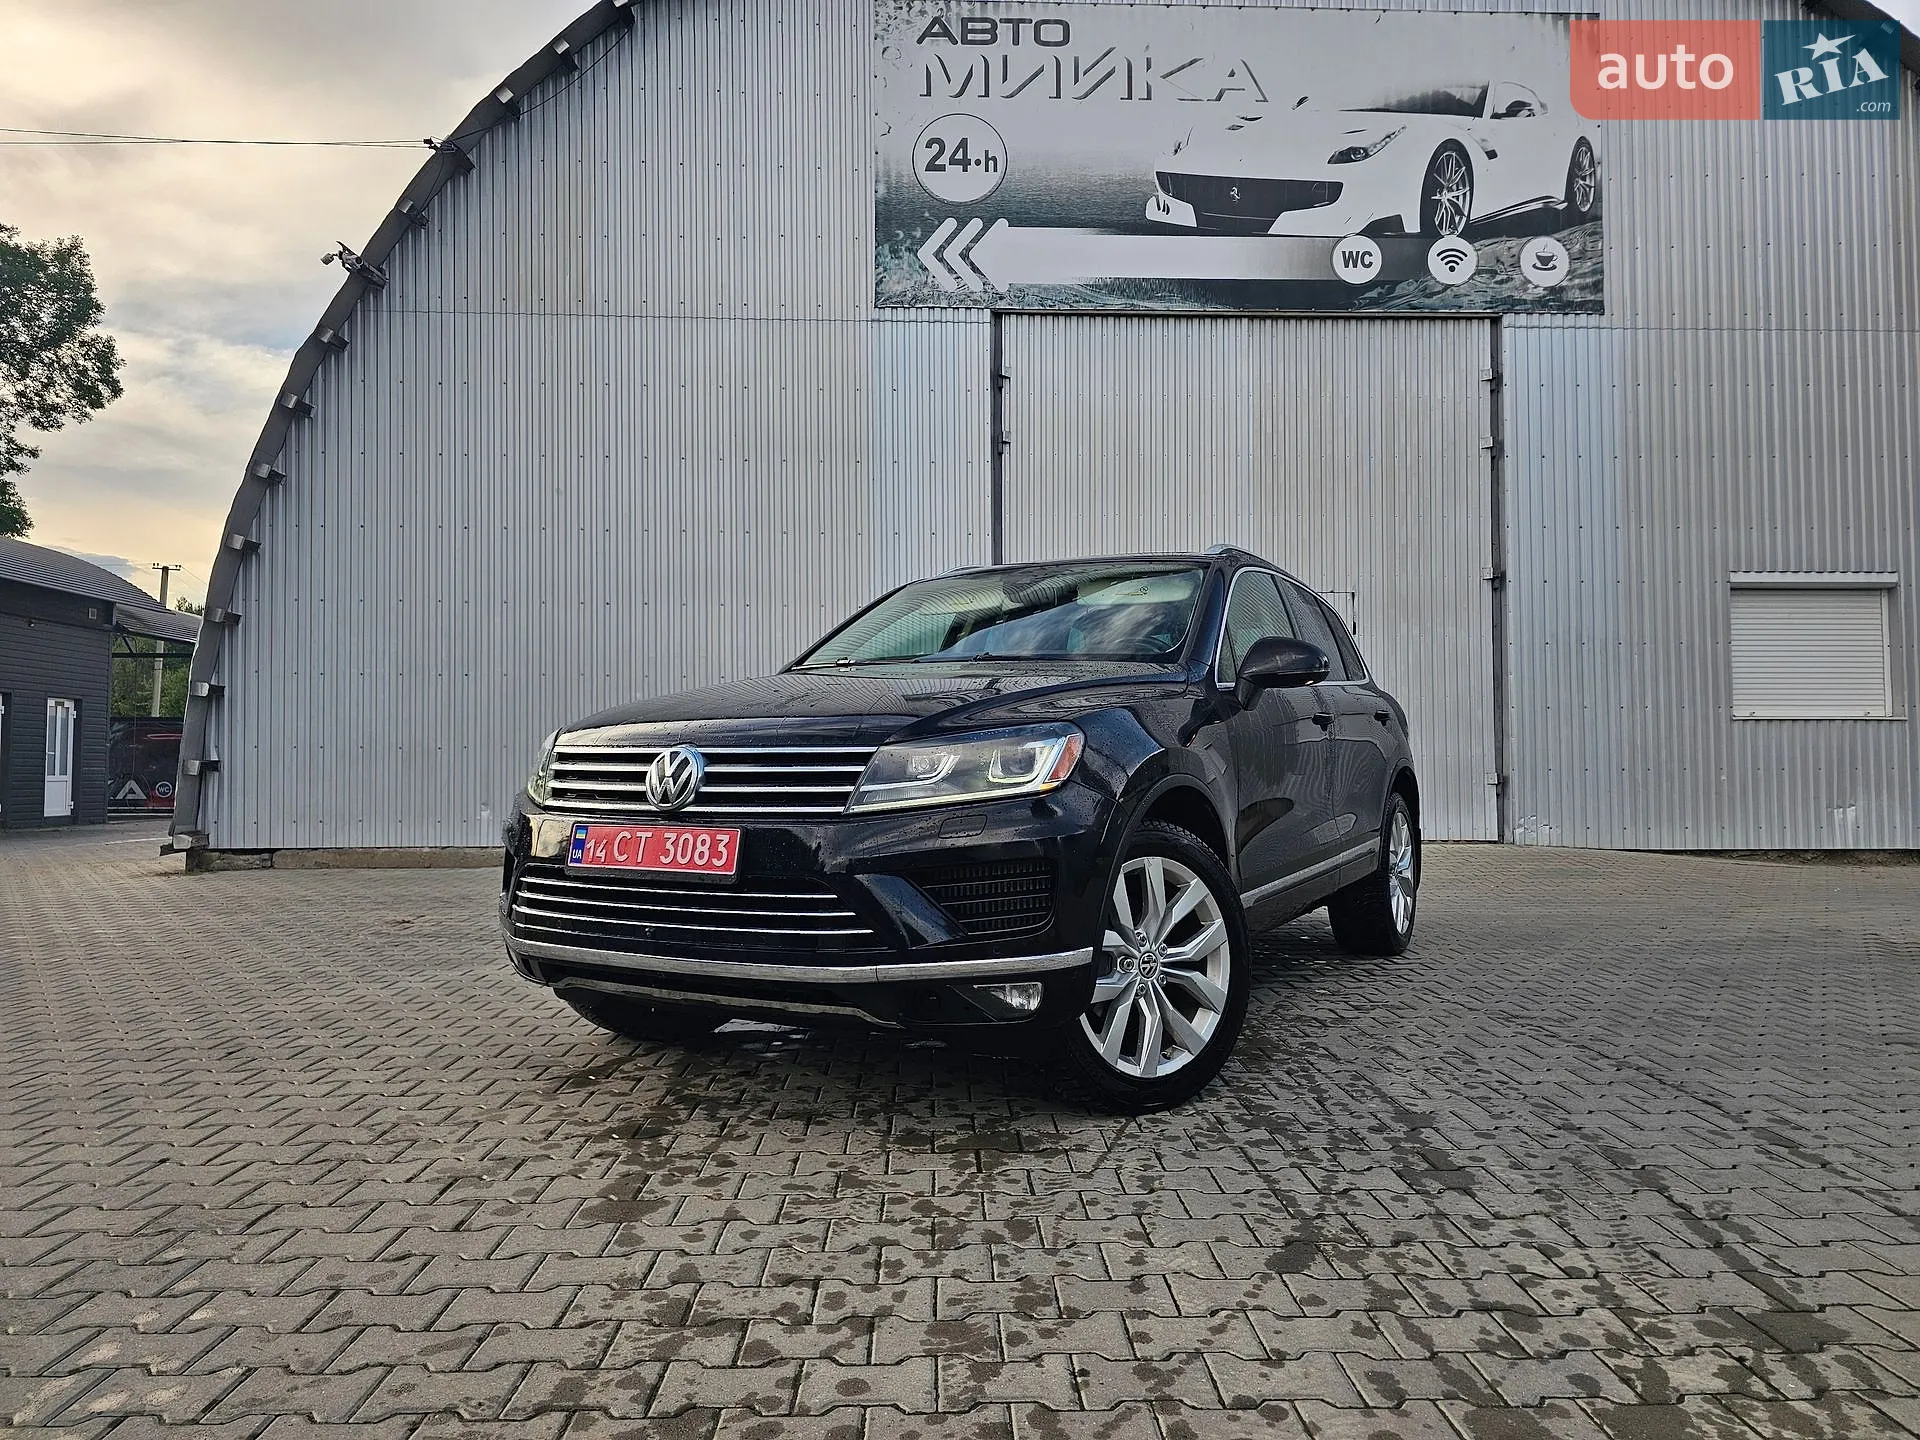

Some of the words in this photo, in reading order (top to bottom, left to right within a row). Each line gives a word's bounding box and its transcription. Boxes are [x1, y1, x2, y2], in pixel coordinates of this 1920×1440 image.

[916, 16, 1070, 46] АВТО
[1341, 250, 1374, 269] WC
[158, 785, 170, 793] WC
[572, 849, 582, 860] UA
[659, 832, 730, 867] 3083
